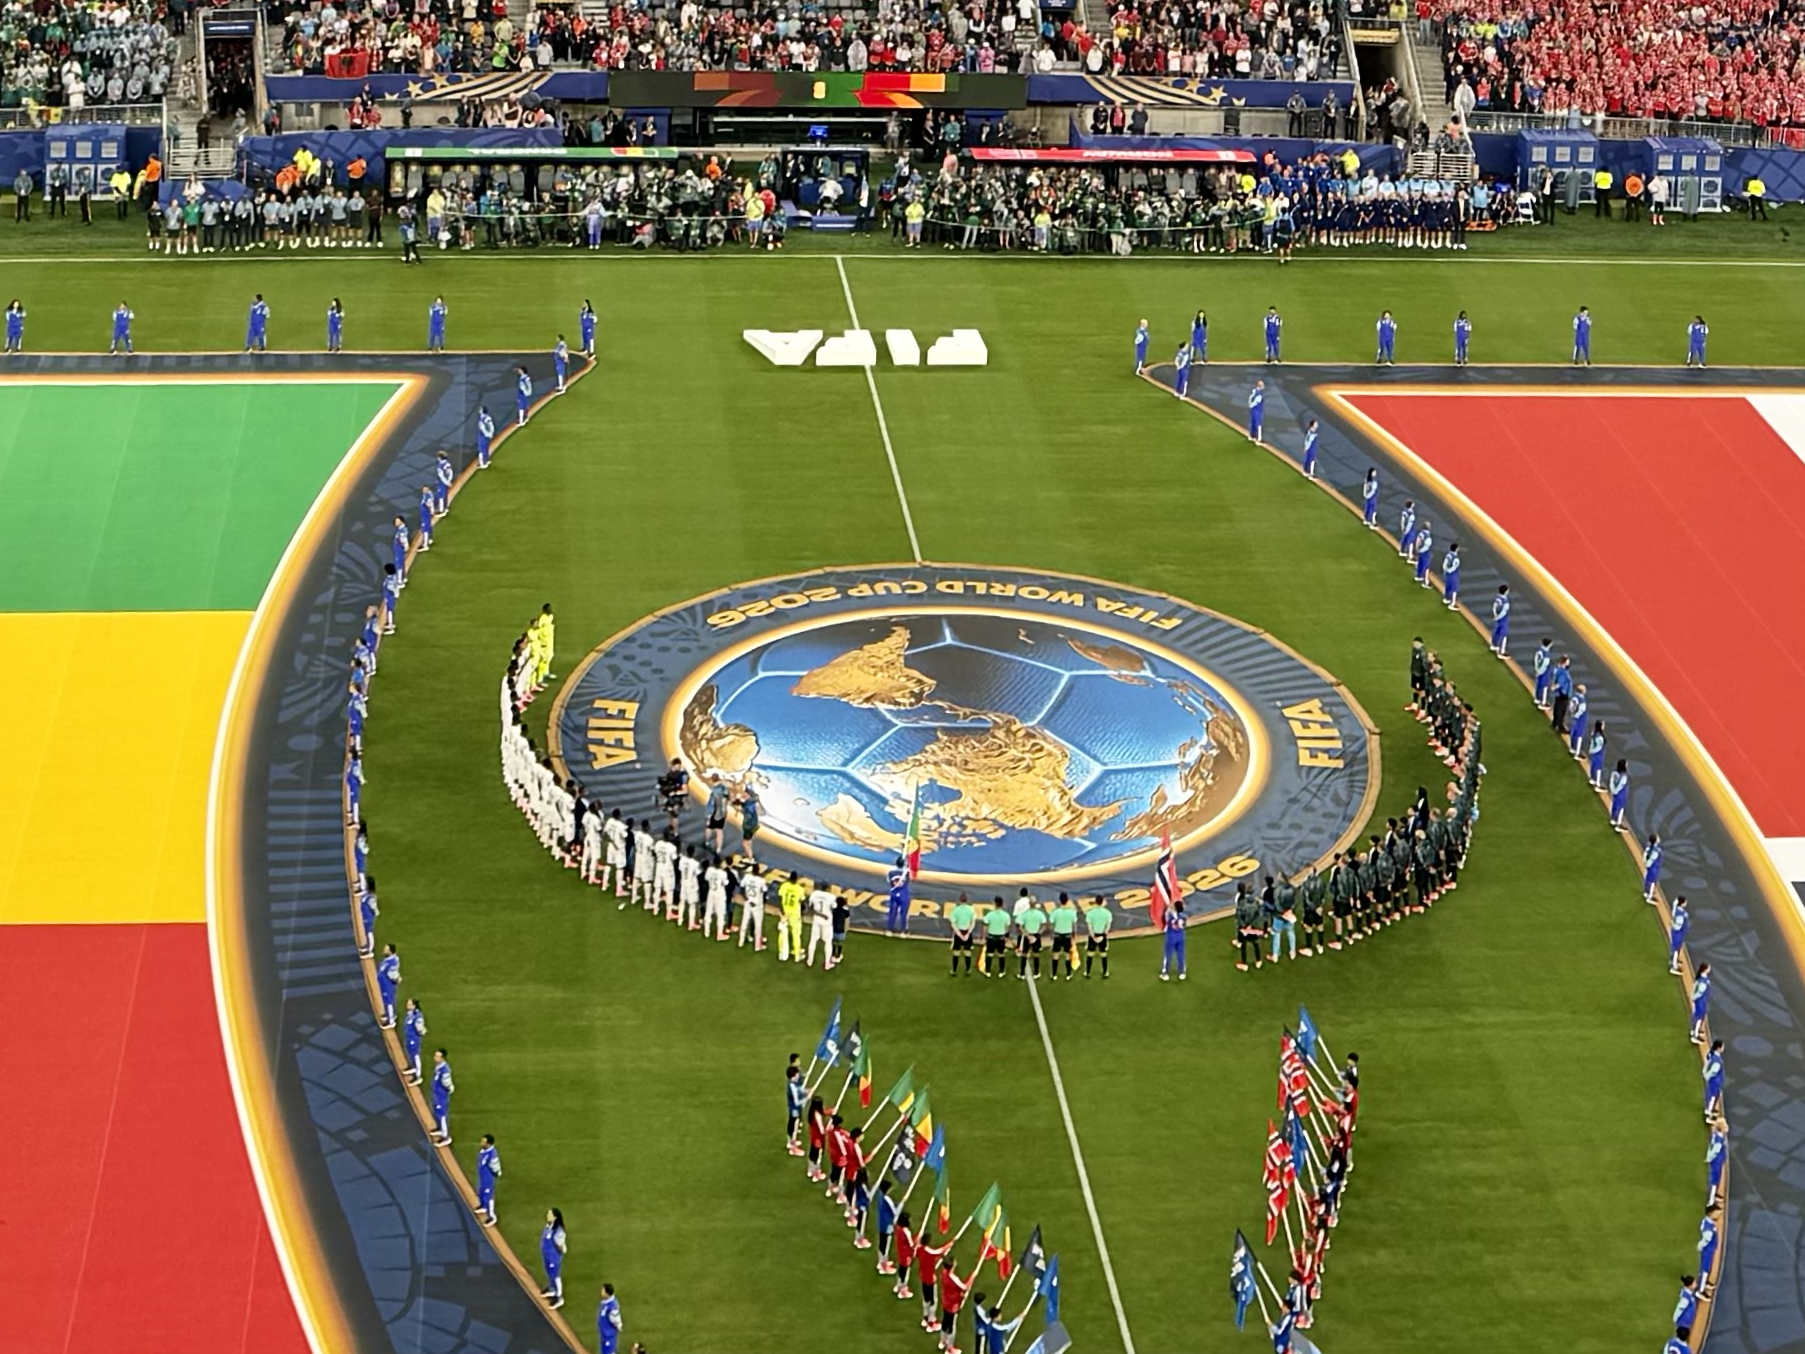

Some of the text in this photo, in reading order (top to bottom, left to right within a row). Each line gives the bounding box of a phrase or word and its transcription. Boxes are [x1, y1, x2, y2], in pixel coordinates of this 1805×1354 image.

[706, 580, 1183, 630] FIFA WORLD CUP 2026
[587, 698, 640, 770] FIFA
[1281, 698, 1344, 769] FIFA
[1114, 855, 1261, 910] 226
